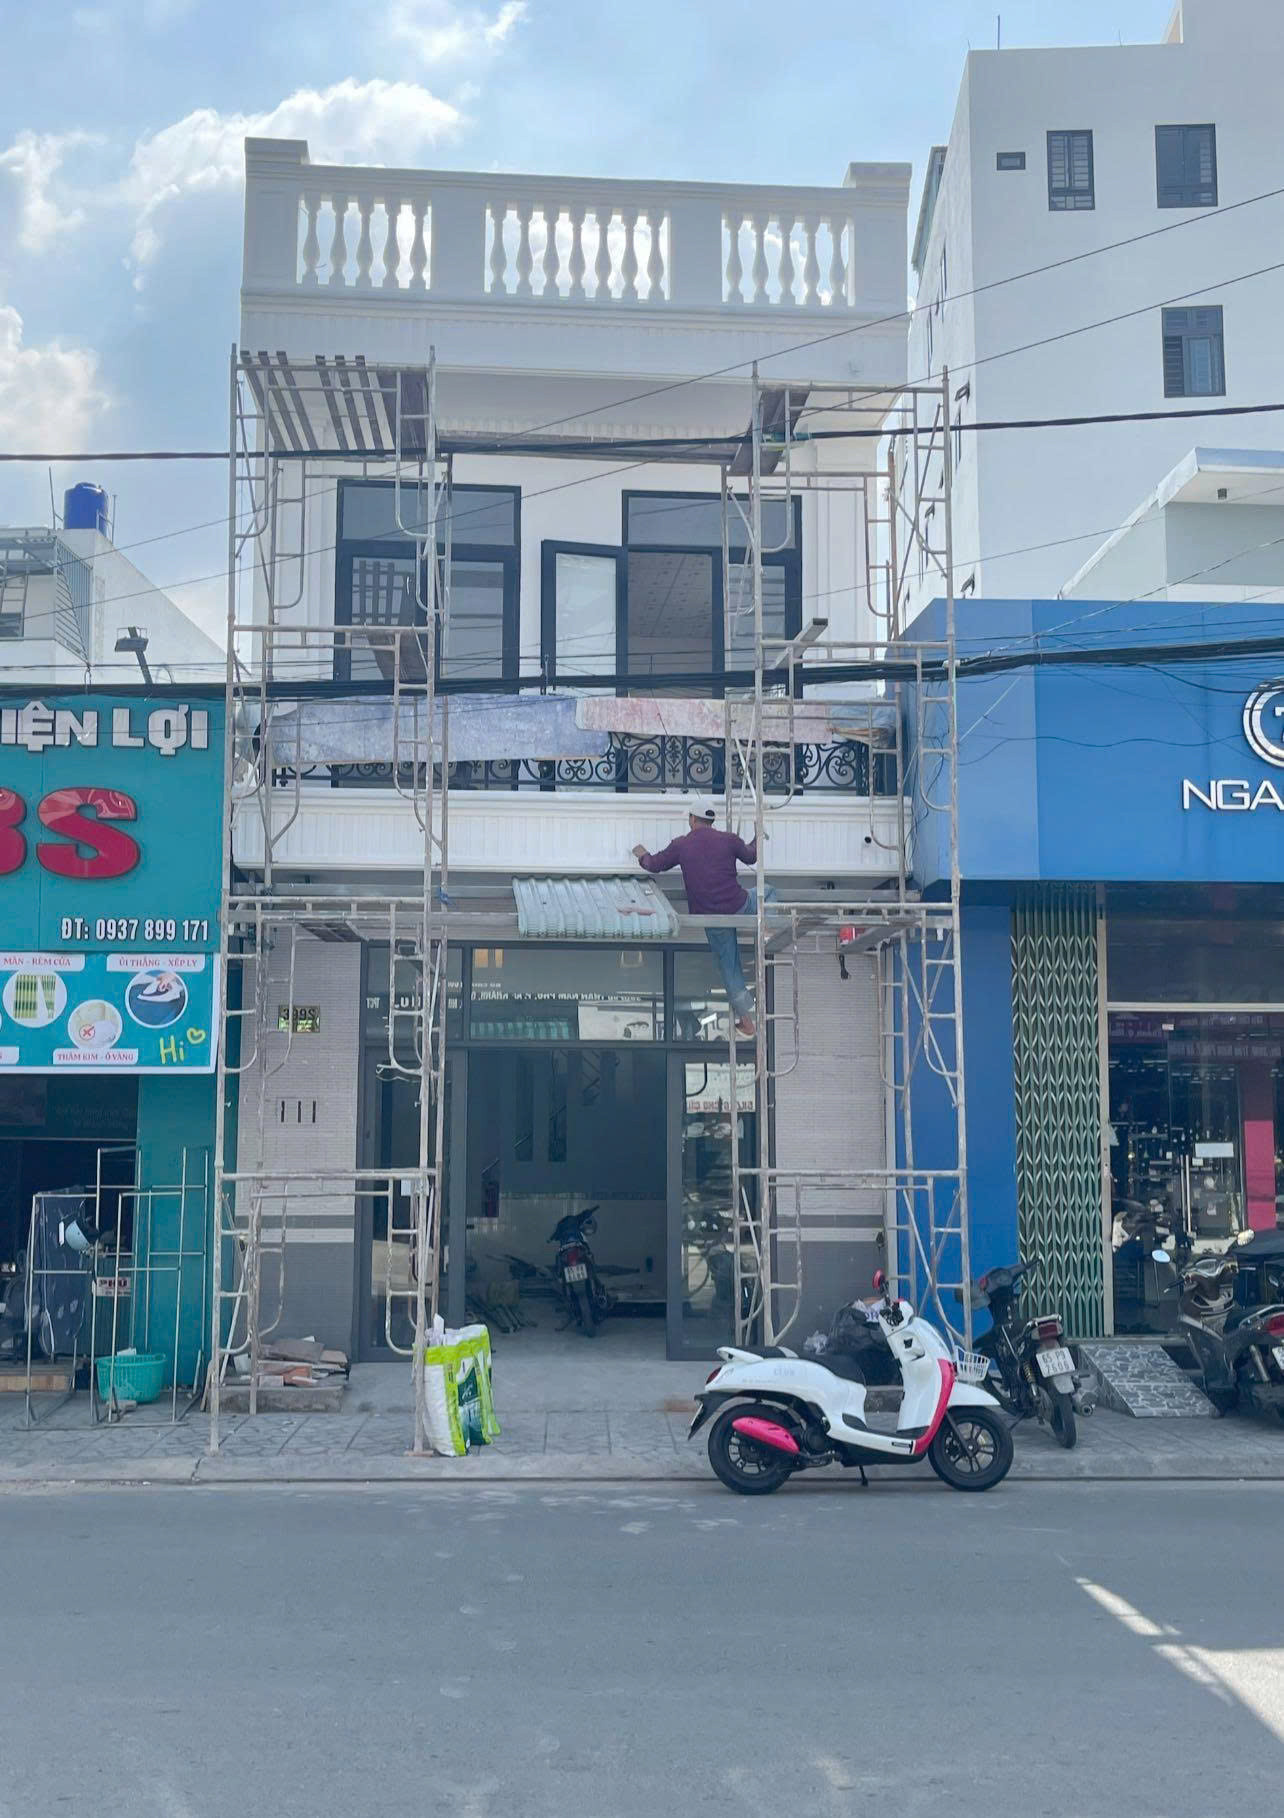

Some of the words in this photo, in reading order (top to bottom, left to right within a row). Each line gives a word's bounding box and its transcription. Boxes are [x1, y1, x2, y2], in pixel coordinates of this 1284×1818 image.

[112, 704, 209, 756] LỢI
[1183, 779, 1284, 810] NGA
[61, 917, 89, 940] ĐT:
[96, 919, 139, 940] 0937
[144, 919, 177, 940] 899
[182, 920, 208, 941] 171
[159, 1035, 185, 1064] Hi
